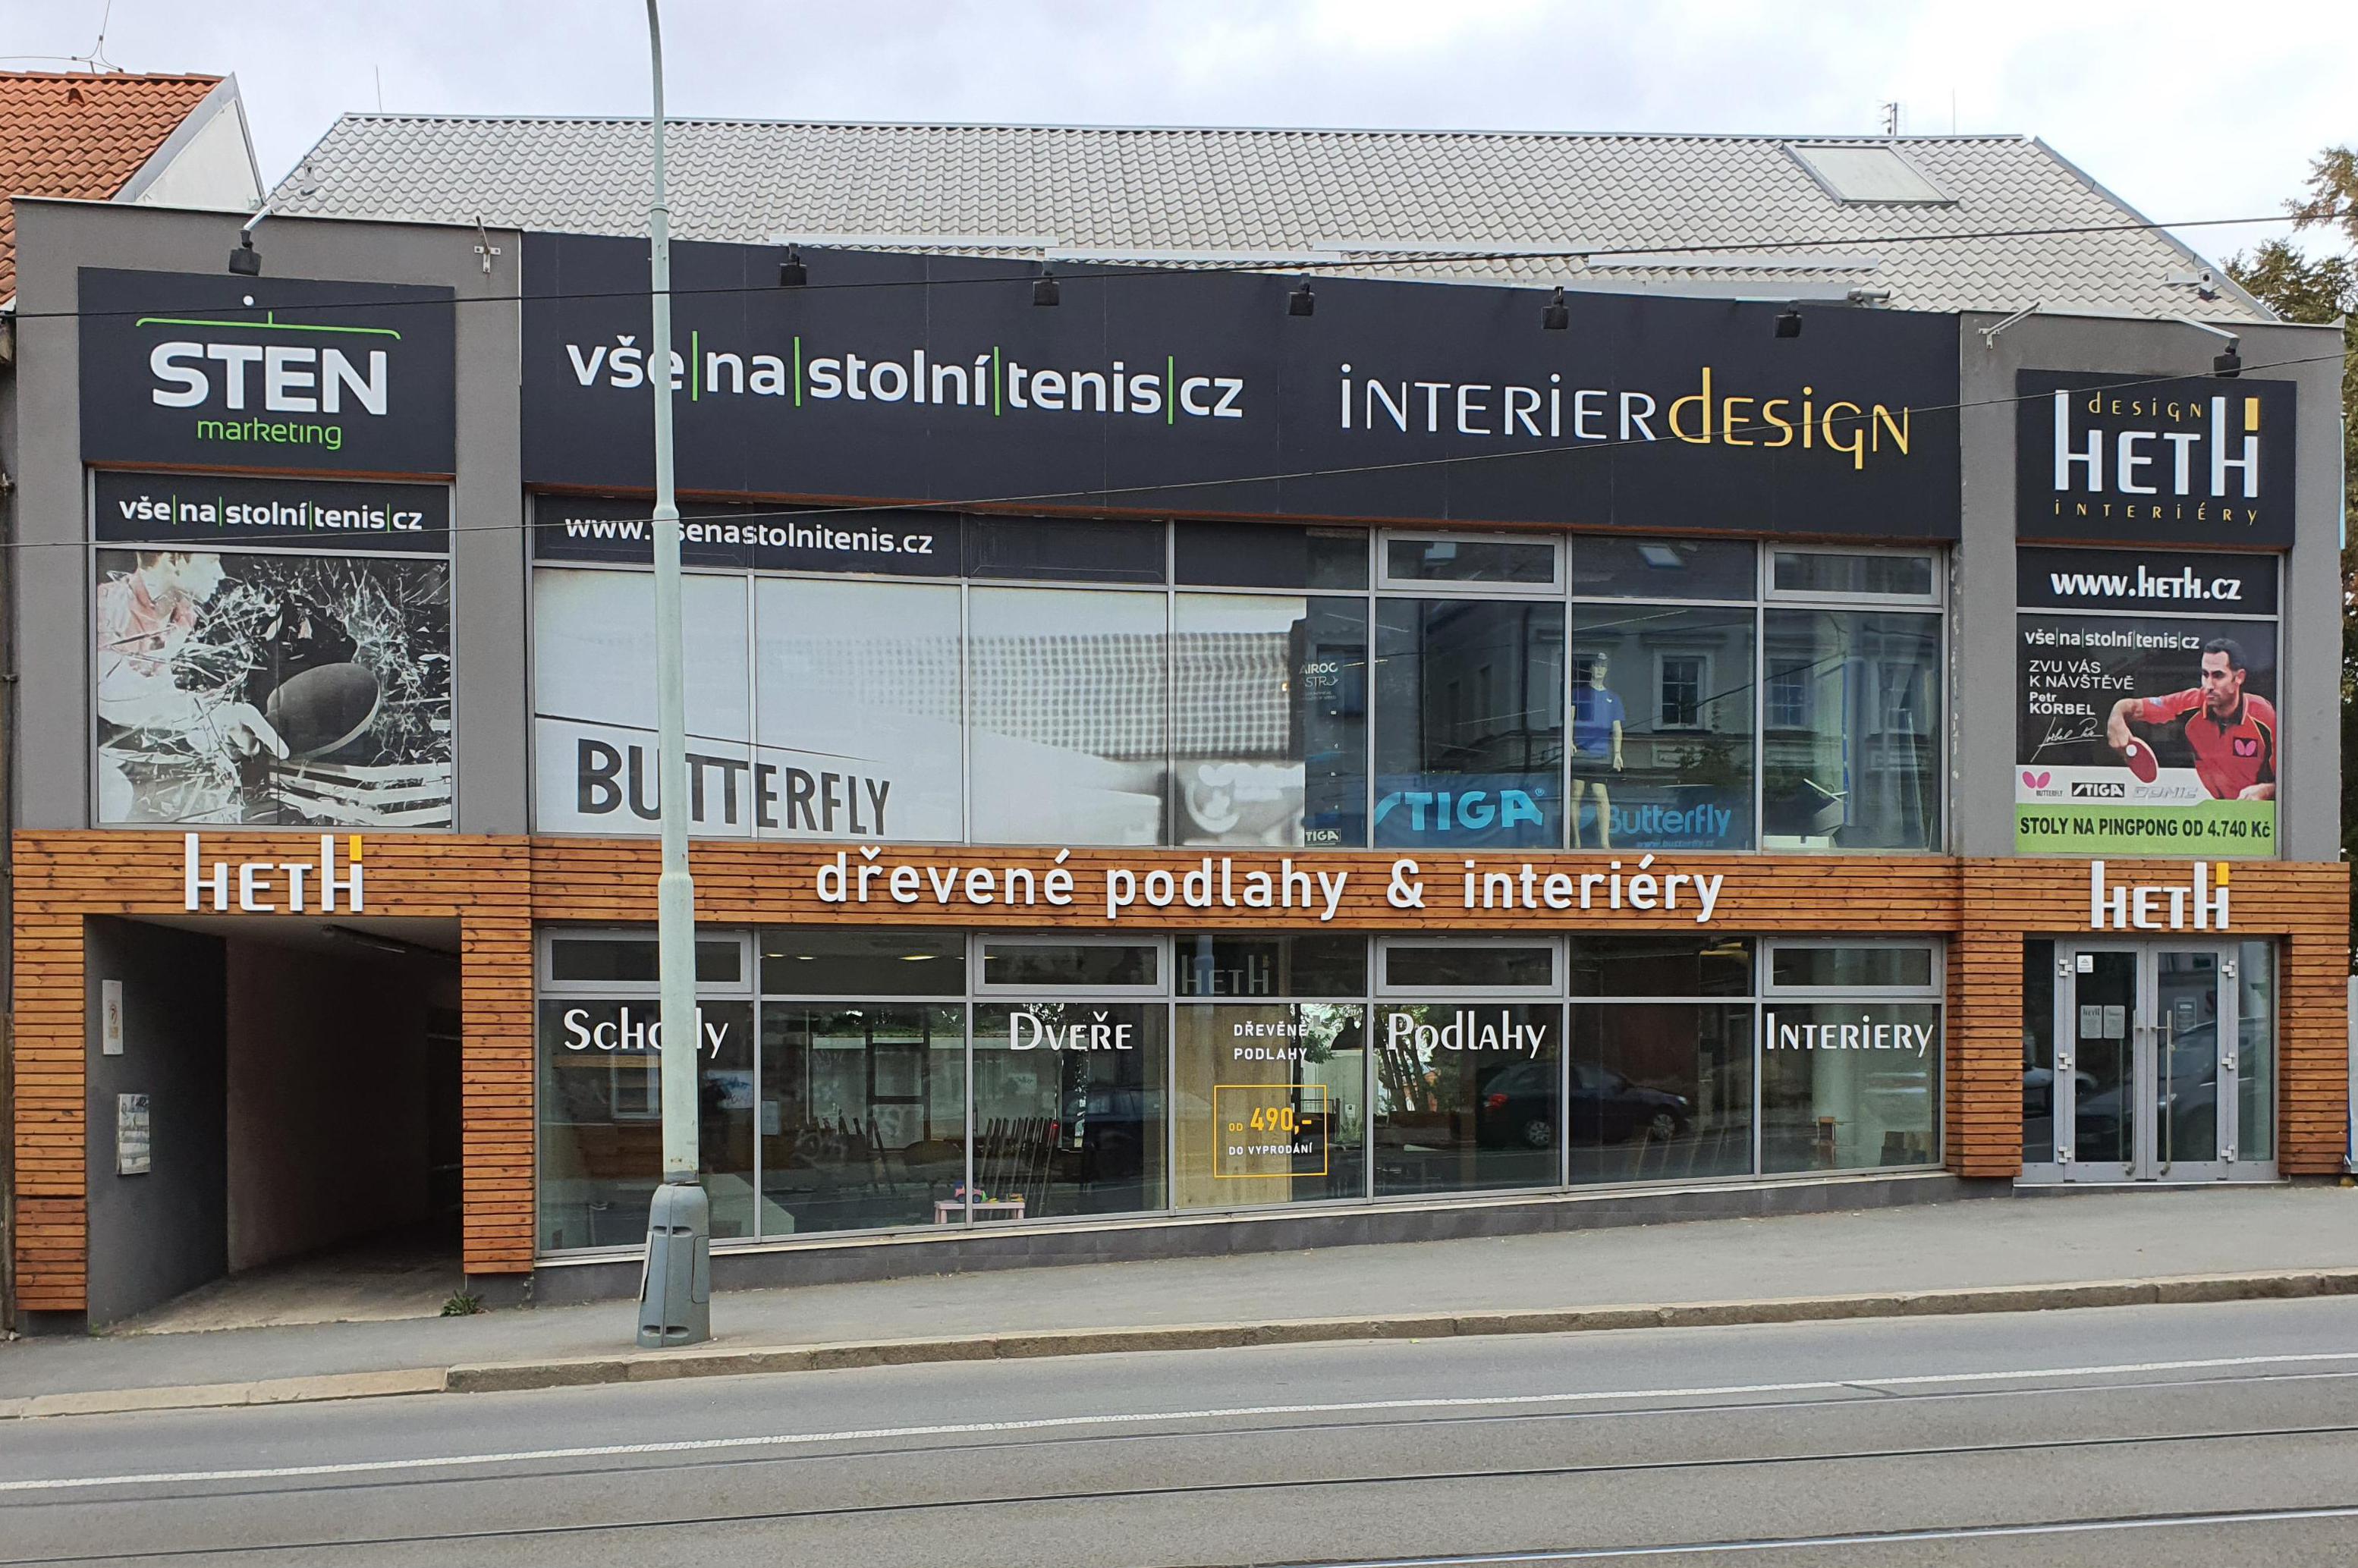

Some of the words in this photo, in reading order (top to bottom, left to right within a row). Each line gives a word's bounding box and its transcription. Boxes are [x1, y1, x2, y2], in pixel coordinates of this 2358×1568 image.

[150, 341, 387, 415] STEN
[197, 416, 341, 451] marketing
[2055, 389, 2259, 498] HETH
[564, 518, 933, 555] www.enastolnitenis.cz
[2029, 659, 2063, 673] ZVU
[2067, 658, 2102, 674] VÁS
[2029, 675, 2041, 688] K
[2045, 673, 2135, 690] NÁVŠTĚVĚ
[2029, 692, 2057, 702] Petr
[2029, 702, 2095, 715] KORBEL
[577, 738, 890, 835] BUTTERFLY
[2073, 784, 2124, 797] STIGA
[1608, 803, 1731, 837] Butterfly
[2020, 817, 2068, 834] STOLY
[2073, 819, 2094, 835] NA
[2099, 819, 2177, 837] PINGPONG
[2182, 820, 2203, 837] OD
[2208, 820, 2246, 837] 4.740
[2251, 821, 2271, 837] Kč
[1305, 831, 1339, 841] TIGA
[184, 833, 363, 912] HETH
[1105, 857, 1347, 921] podlahy
[1386, 859, 1426, 909] &
[1464, 853, 1724, 923] interiéry
[2091, 860, 2230, 929] HETH
[1234, 1048, 1308, 1060] PODLAHY
[1228, 1123, 1243, 1131] OD
[1250, 1107, 1313, 1135] 490,-
[1228, 1146, 1243, 1155] DO
[1247, 1142, 1313, 1155] VYPRODÁNÍ
